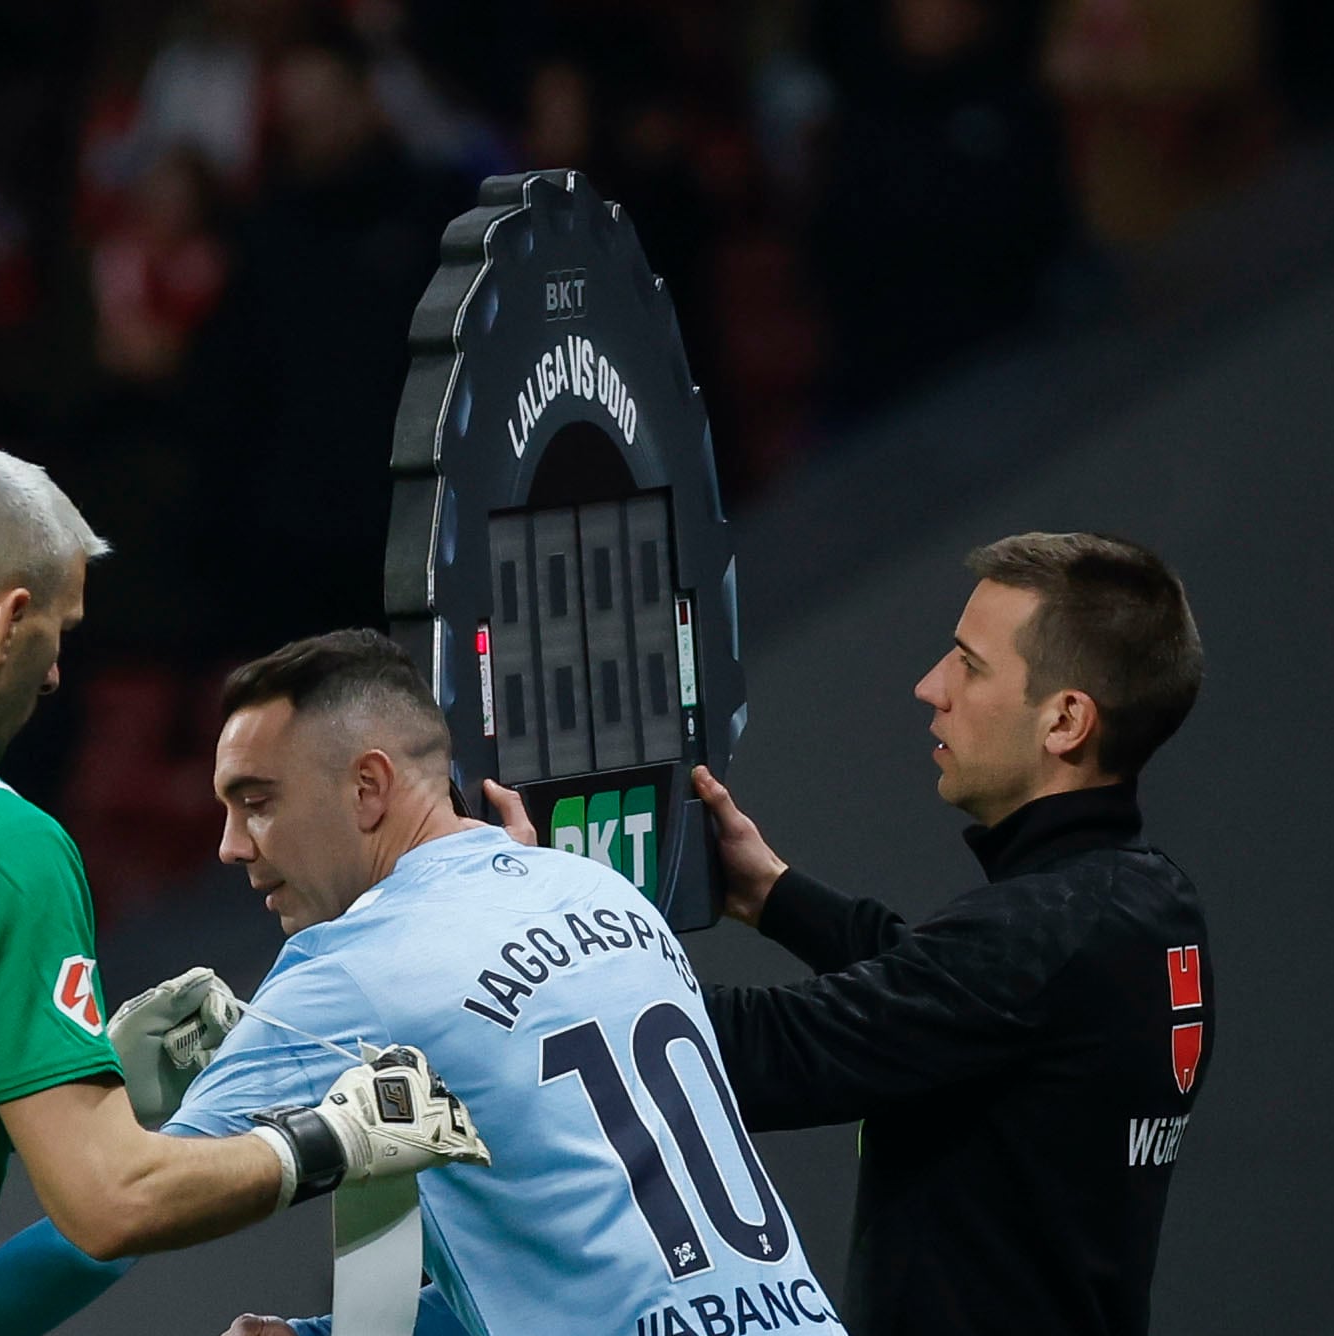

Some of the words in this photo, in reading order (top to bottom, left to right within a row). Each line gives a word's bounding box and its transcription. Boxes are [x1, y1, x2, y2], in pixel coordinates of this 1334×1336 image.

[546, 280, 586, 312] BKT
[508, 345, 569, 459] LALIGA
[567, 335, 595, 401] VS
[597, 355, 638, 445] ODIO
[462, 927, 572, 1032] IAGO
[563, 908, 699, 996] ASPAS
[538, 999, 791, 1283] 10
